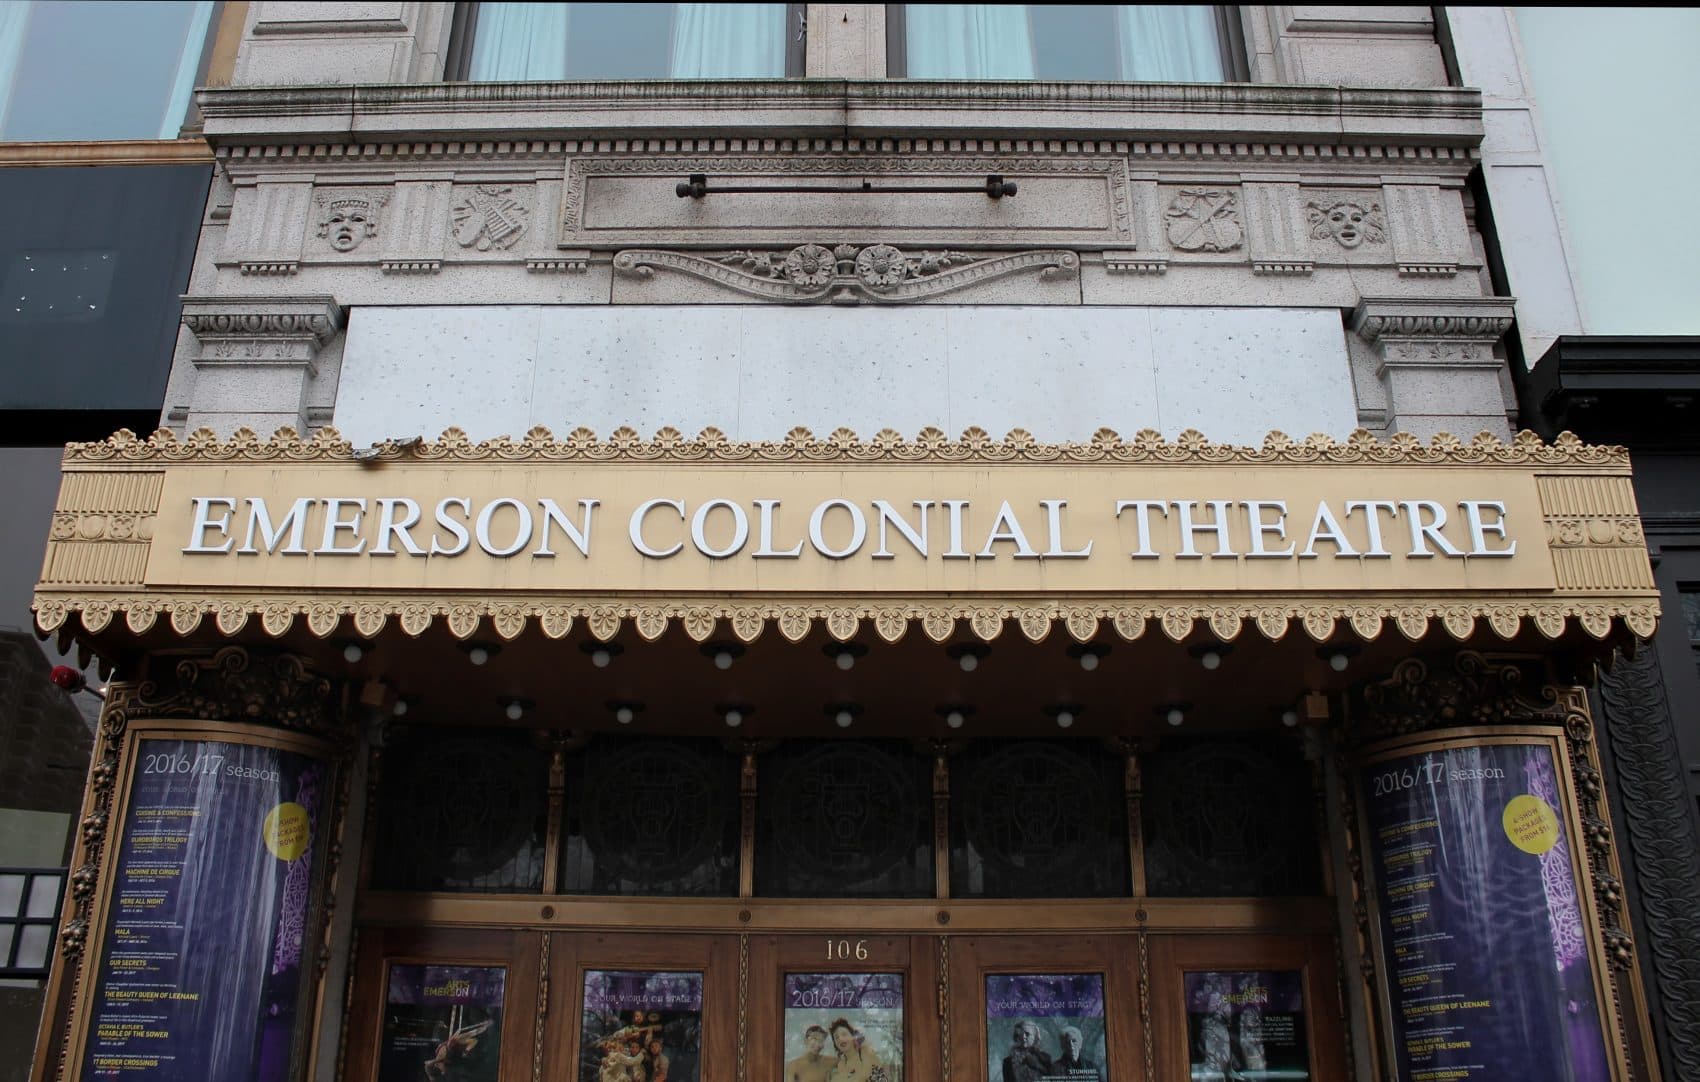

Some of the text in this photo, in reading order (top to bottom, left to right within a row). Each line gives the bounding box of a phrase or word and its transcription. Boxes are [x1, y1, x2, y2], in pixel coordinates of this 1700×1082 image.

[182, 497, 1518, 560] EMERSON COLONIAL THEATRE
[144, 753, 281, 783] 2016/17 season
[1373, 762, 1505, 797] 2016/17 season
[827, 939, 868, 960] 106
[115, 991, 138, 999] BEAUTY
[138, 991, 159, 1000] QUEEN
[168, 992, 199, 1001] LEENANE
[423, 986, 469, 997] EMERSON
[792, 989, 855, 1008] 2016/17
[97, 1029, 123, 1037] PARABLE
[133, 1030, 145, 1038] THE
[145, 1031, 169, 1039] SOWER
